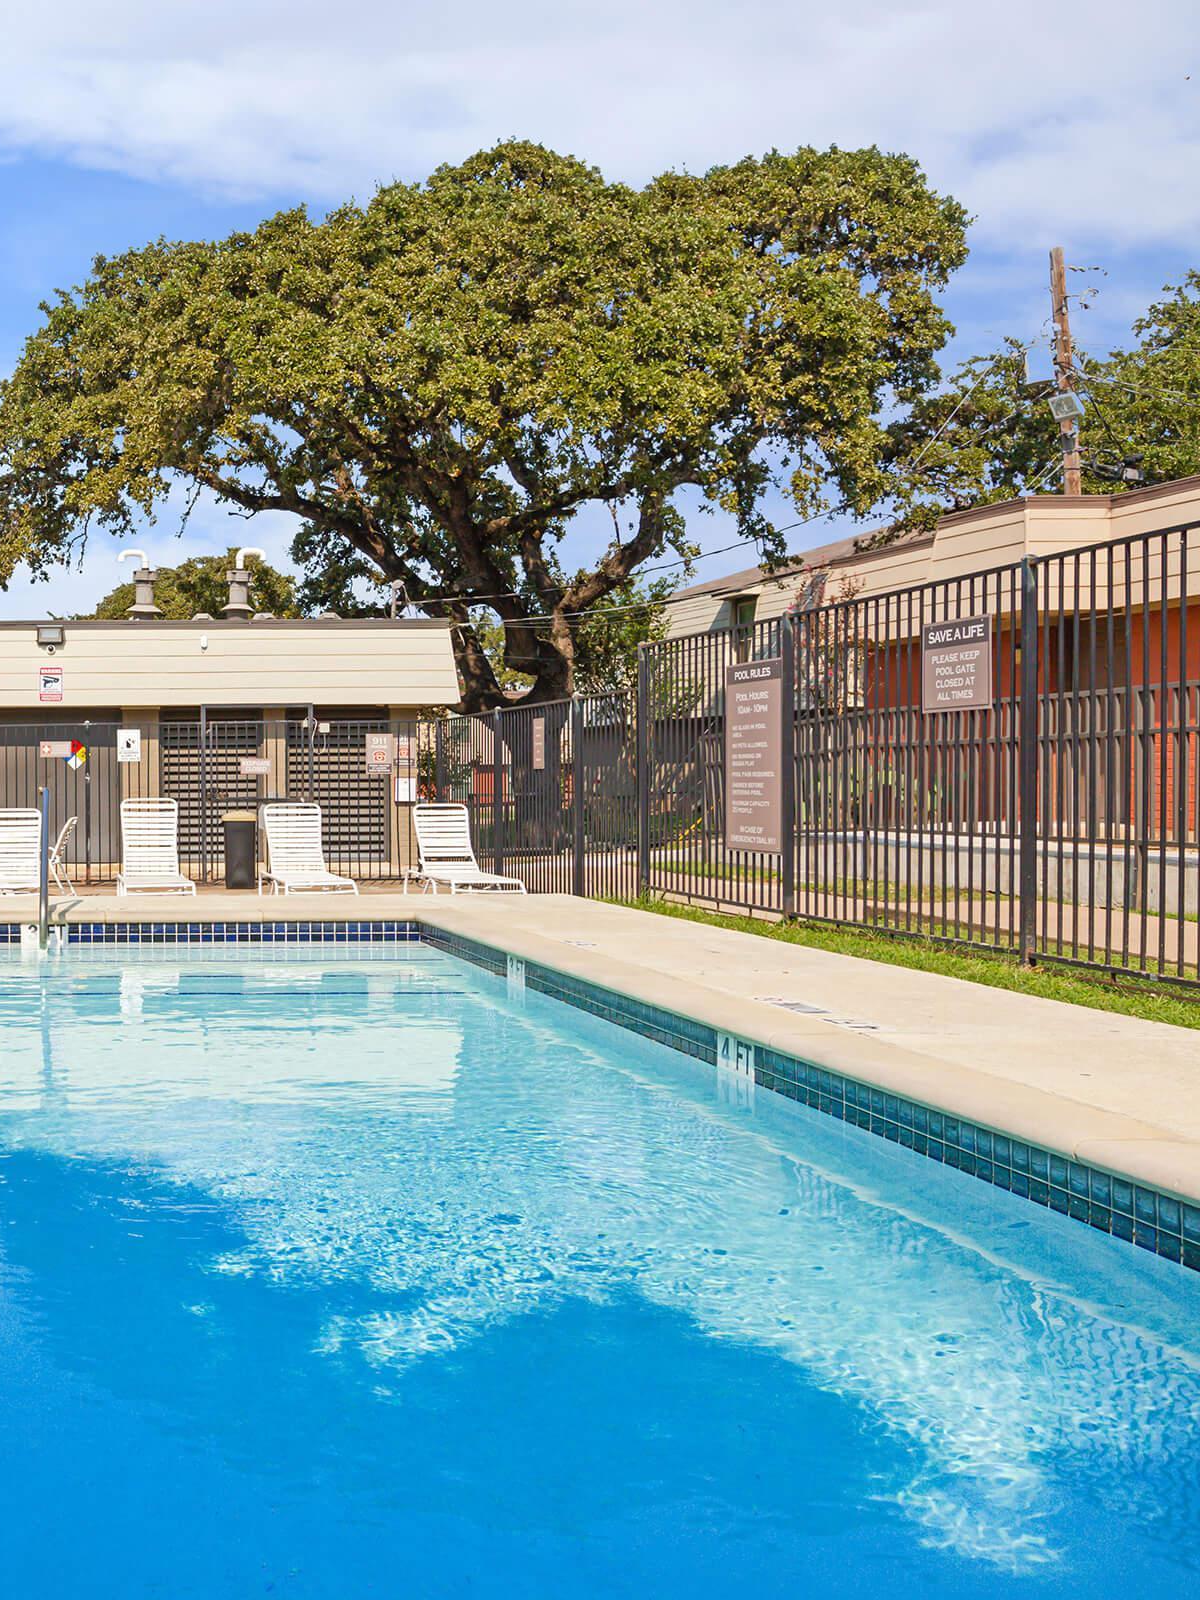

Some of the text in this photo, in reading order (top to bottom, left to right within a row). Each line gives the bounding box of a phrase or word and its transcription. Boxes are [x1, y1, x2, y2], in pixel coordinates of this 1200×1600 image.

[928, 624, 984, 644] SAVE A LIFE
[932, 650, 980, 664] PLEASE KEEP
[734, 667, 771, 680] POOL RULES
[936, 664, 976, 676] POOL GATE
[936, 677, 975, 688] CLOSED AT
[937, 690, 974, 701] ALL TIMES
[48, 924, 66, 940] FT
[722, 1037, 752, 1075] 4 FT
